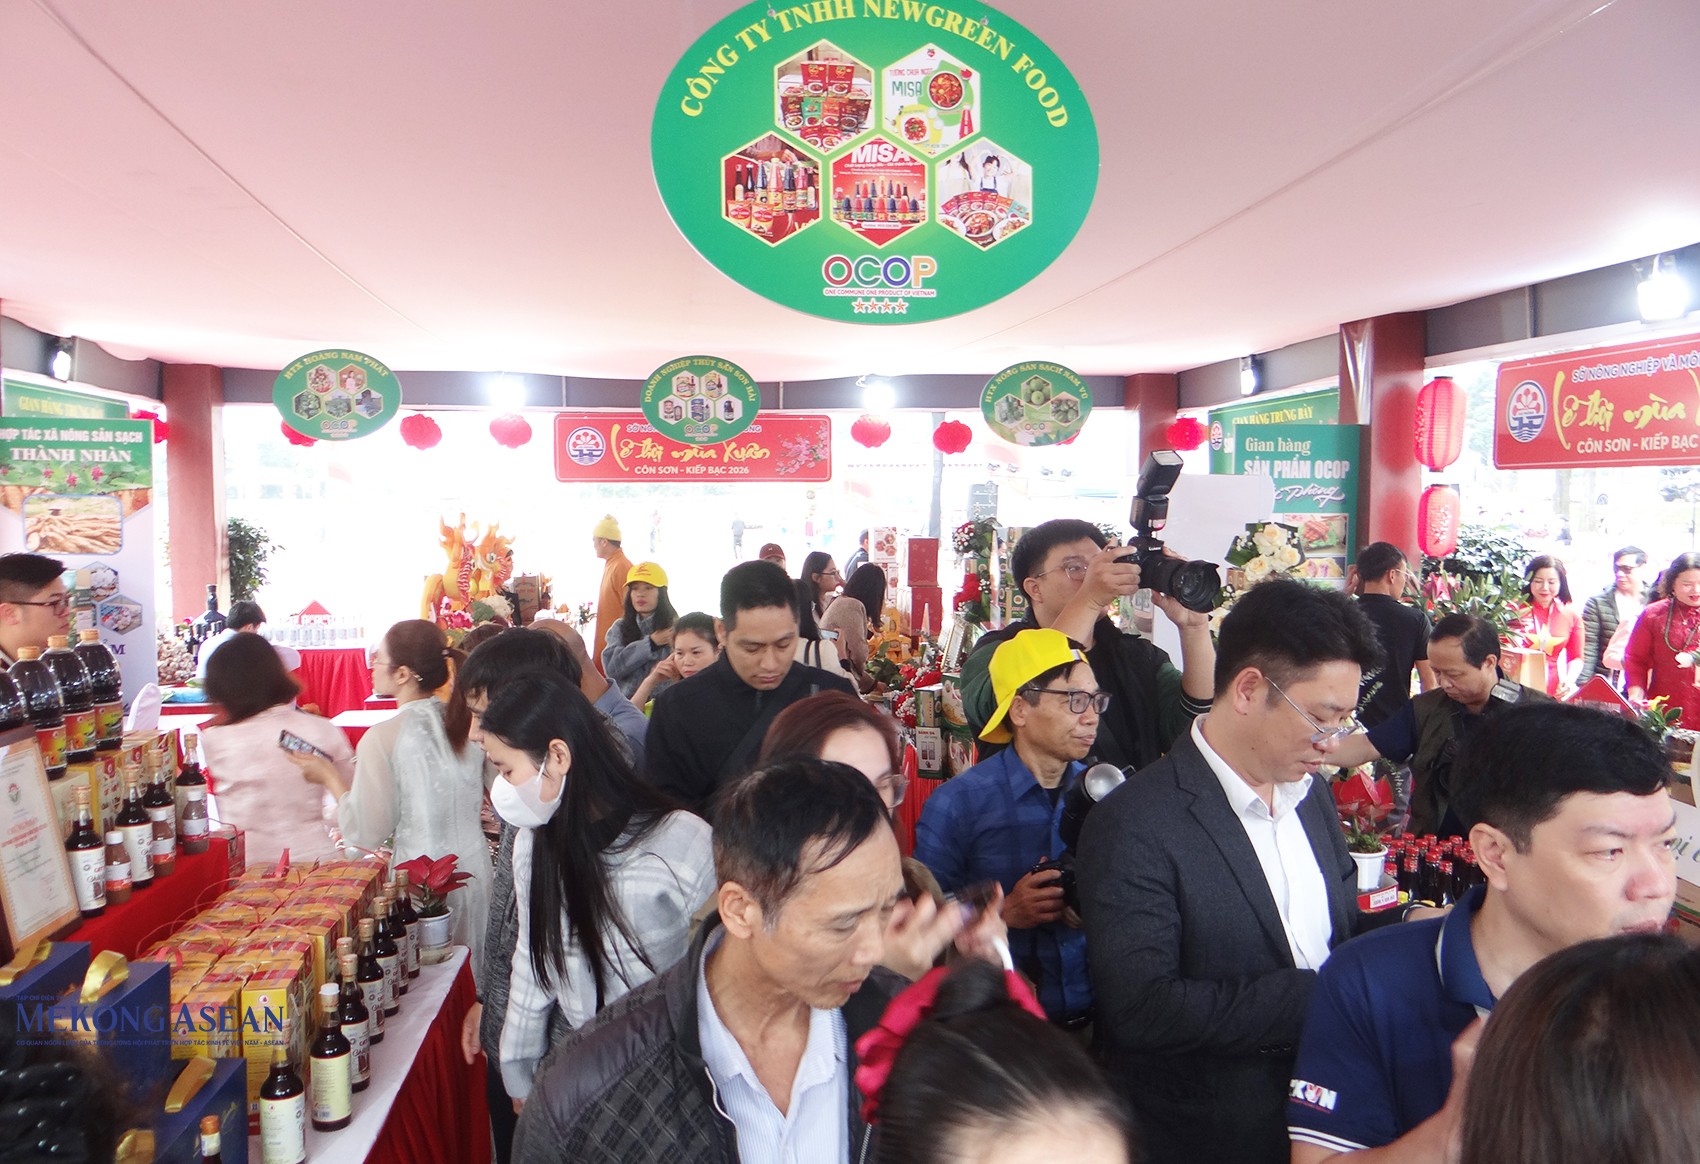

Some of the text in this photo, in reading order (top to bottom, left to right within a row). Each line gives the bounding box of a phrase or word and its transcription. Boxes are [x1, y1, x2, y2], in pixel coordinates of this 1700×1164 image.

[681, 0, 1068, 128] CÔNG TY TNHH NEWGREEN FOOD
[892, 81, 922, 97] MISA
[851, 143, 910, 163] MISA
[823, 256, 936, 287] OCOP
[1572, 366, 1586, 382] SỞ
[1588, 364, 1618, 381] NÔNG
[1620, 356, 1660, 377] NGHIỆP
[1662, 353, 1677, 371] VÀ
[644, 374, 662, 402] DOANH
[1270, 408, 1296, 424] TRƯNG
[1298, 404, 1313, 420] BÀY
[22, 427, 42, 440] TÁC
[44, 428, 58, 441] XÃ
[60, 428, 90, 442] NÔNG
[92, 428, 113, 442] SẢN
[115, 432, 143, 444] SẠCH
[1577, 438, 1602, 454] CÔN
[1605, 438, 1631, 452] SƠN
[1640, 432, 1669, 450] KIẾP
[1672, 434, 1699, 452] BẠC
[1246, 438, 1274, 452] Gian
[1278, 438, 1311, 456] hàng
[634, 465, 656, 474] CÔN
[658, 465, 678, 474] SƠN
[686, 464, 706, 474] KIẾP
[708, 466, 726, 476] BẠC
[728, 466, 749, 474] 2026
[1244, 454, 1350, 479] SẢN PHẨM OCOP
